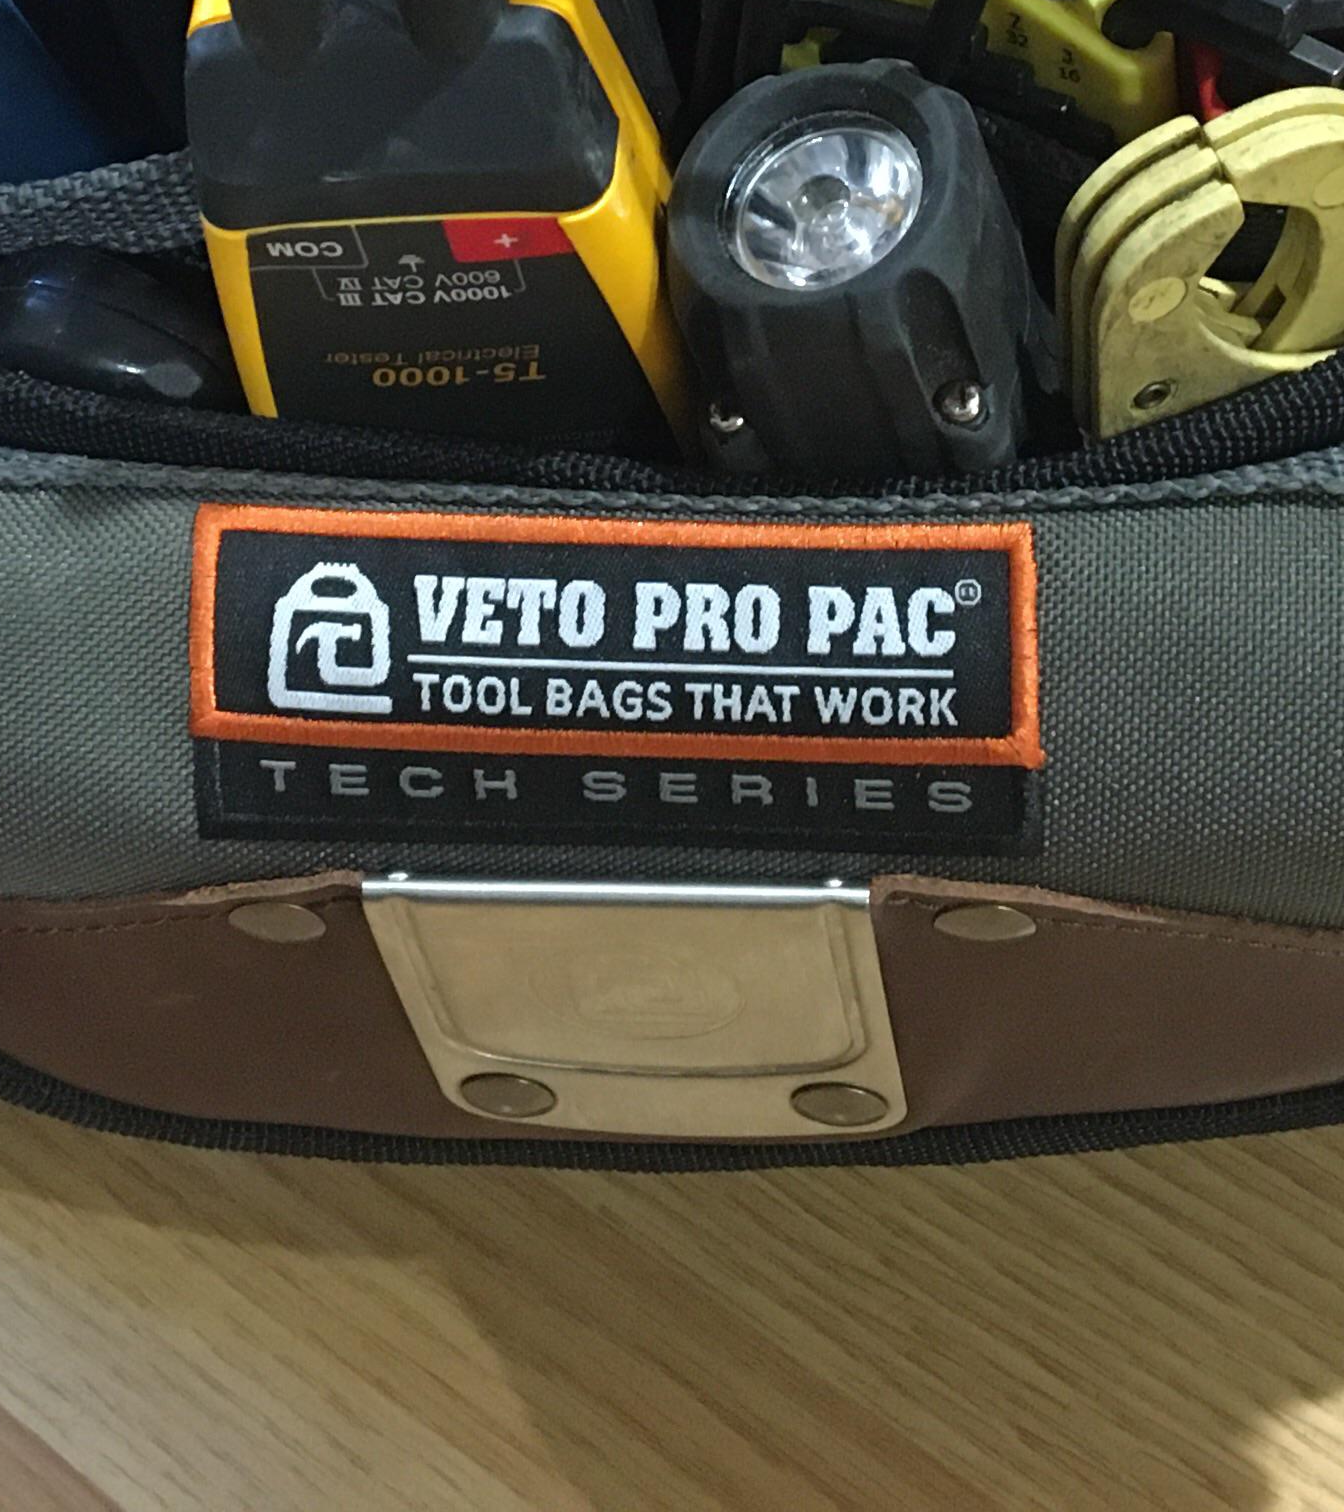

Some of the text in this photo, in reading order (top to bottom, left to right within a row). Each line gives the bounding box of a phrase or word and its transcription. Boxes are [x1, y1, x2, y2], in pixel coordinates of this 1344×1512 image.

[265, 241, 344, 258] COM
[371, 275, 426, 290] CAT
[434, 270, 502, 288] 600V
[371, 291, 427, 307] CAT
[434, 286, 512, 305] 1000V
[324, 344, 540, 367] Electrical Tester
[372, 362, 546, 387] T5-1000
[413, 573, 607, 649] VETO
[633, 582, 781, 654] PRO
[411, 671, 959, 727] TOOL BAGS THAT WORK
[259, 757, 974, 814] TECH SERIES
